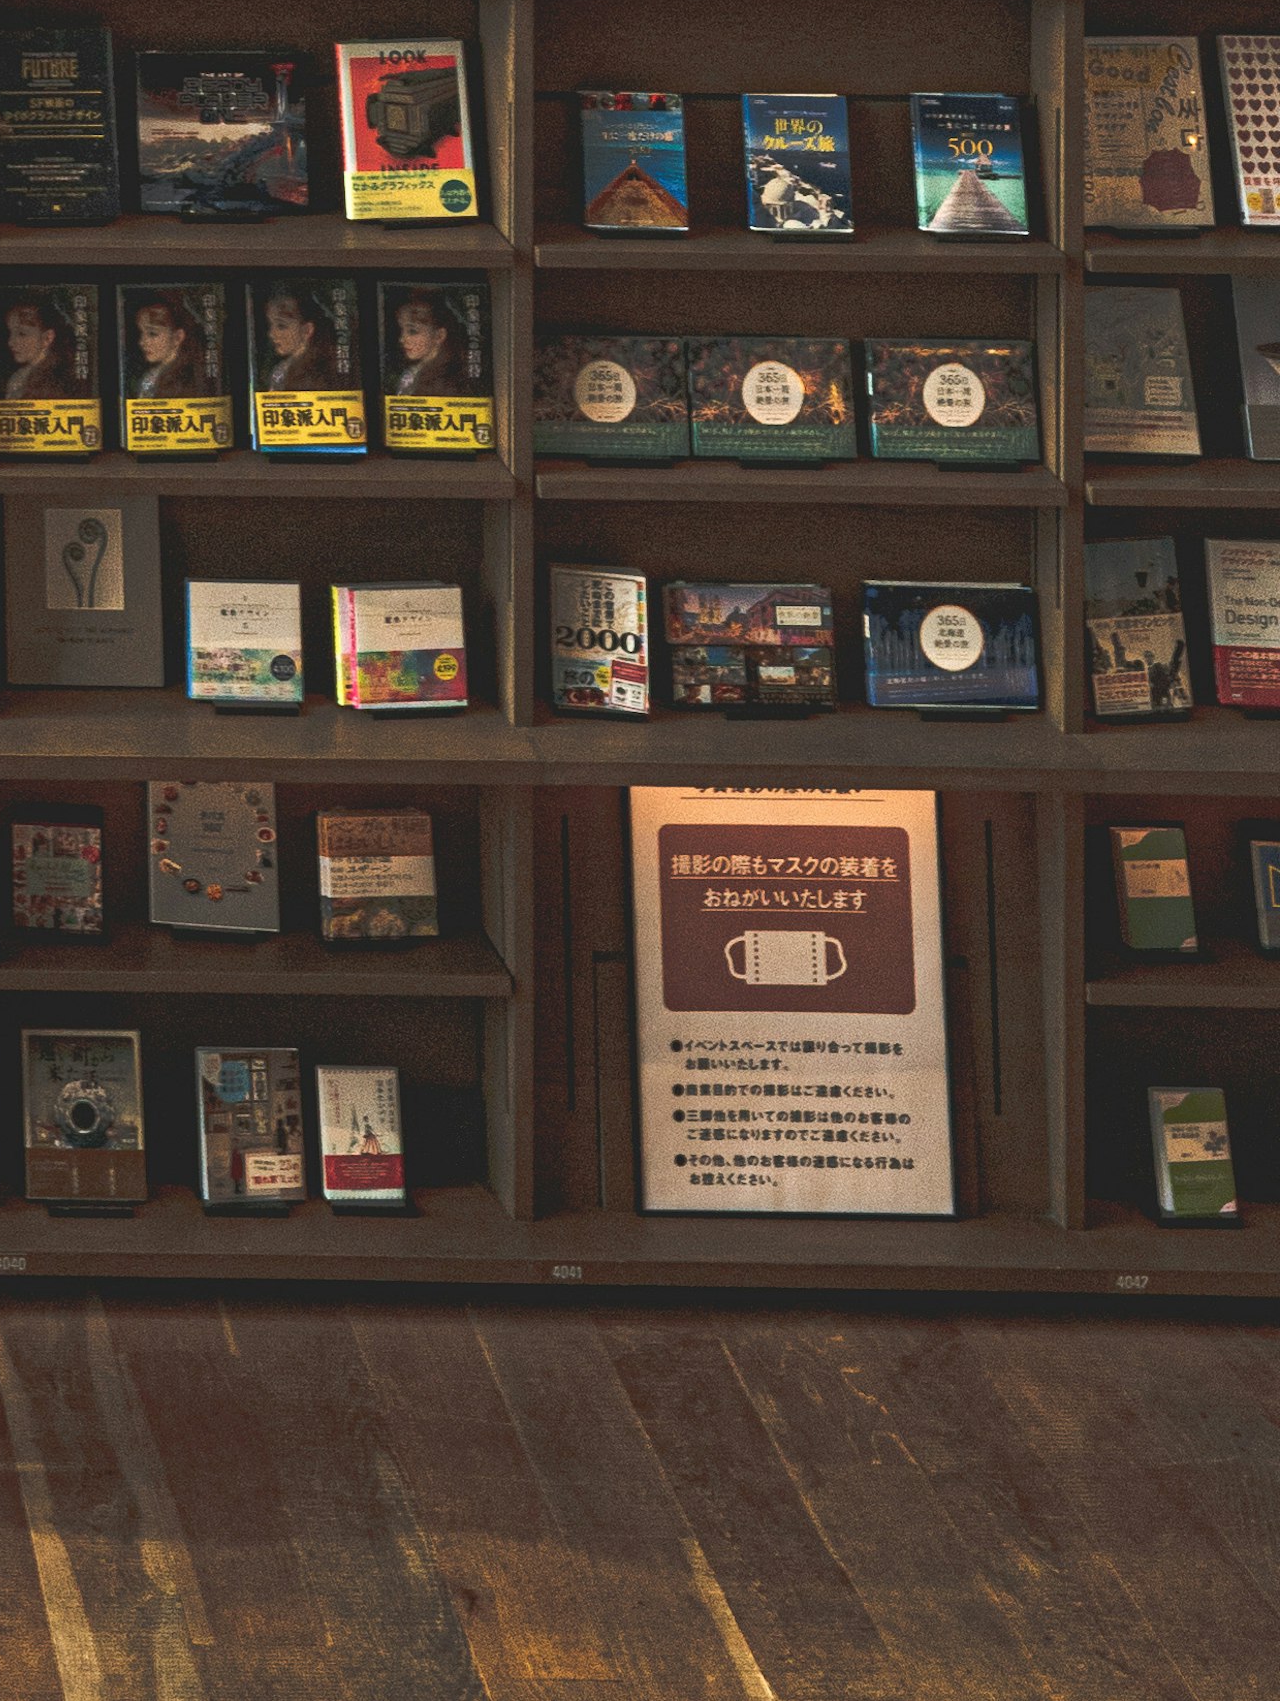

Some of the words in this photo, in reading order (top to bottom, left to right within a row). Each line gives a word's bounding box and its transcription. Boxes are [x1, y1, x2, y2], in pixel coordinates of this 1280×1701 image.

[774, 117, 824, 135] 世界の
[948, 137, 994, 157] 500
[260, 408, 348, 428] 印象派入門
[388, 412, 477, 432] 印象派入門
[1224, 608, 1280, 629] Design
[555, 625, 641, 654] 2000
[671, 854, 898, 878] 撮影の際もマスクの装着を
[703, 888, 868, 910] おねがいいたします
[552, 1265, 582, 1279] 4041
[1116, 1275, 1149, 1289] 4042
